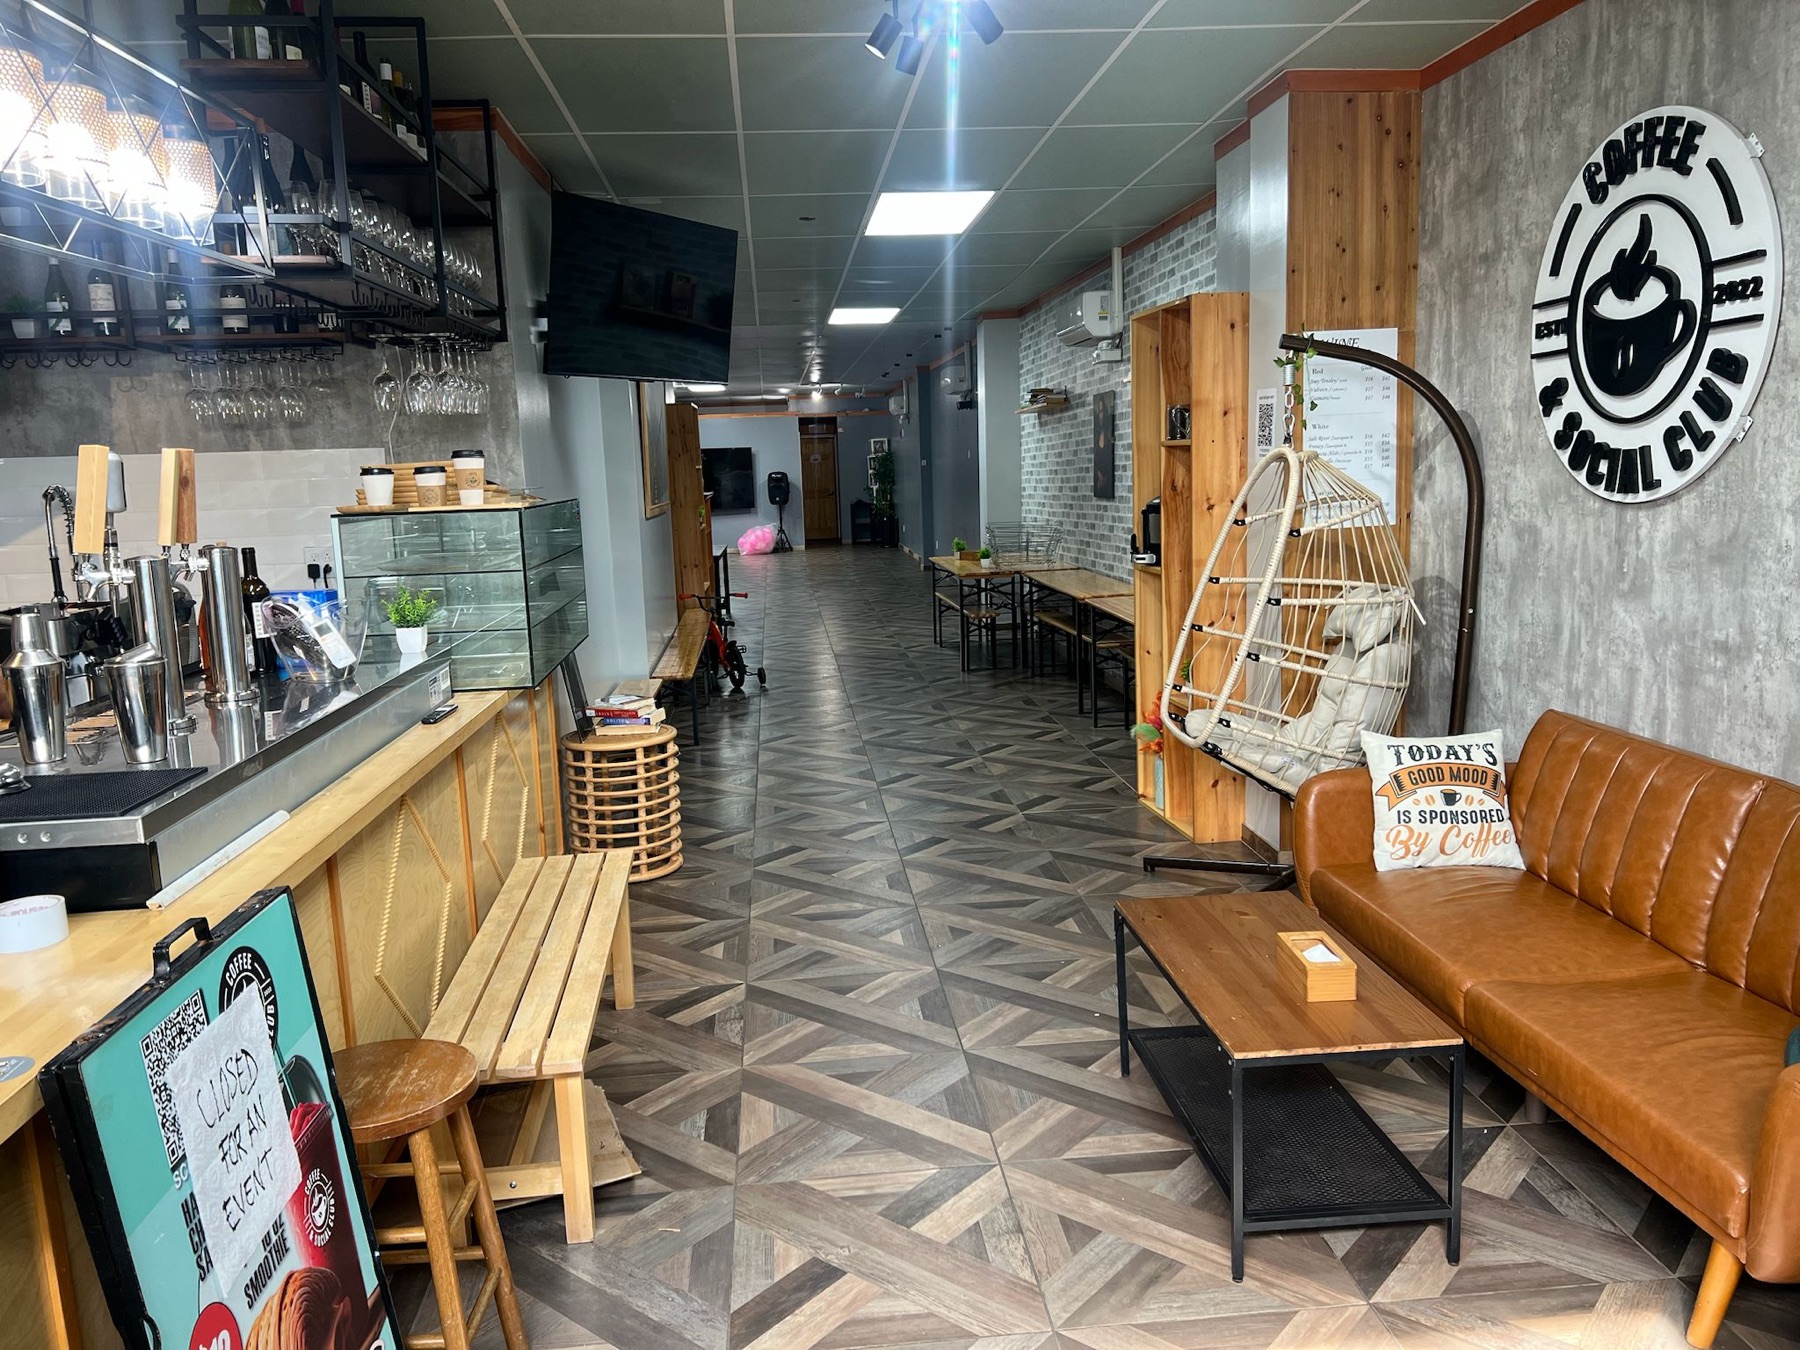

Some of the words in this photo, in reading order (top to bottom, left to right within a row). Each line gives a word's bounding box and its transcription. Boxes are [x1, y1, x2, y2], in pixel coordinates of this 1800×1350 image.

[1582, 115, 1706, 204] COFFEE
[1712, 275, 1764, 305] 2022
[1554, 411, 1662, 495] SOCIAL
[1662, 347, 1749, 472] CLUB
[1387, 743, 1498, 767] TODAY'S
[1407, 768, 1445, 786] GOOD
[1449, 766, 1488, 786] MOOD
[1397, 810, 1412, 825] IS
[1418, 808, 1505, 825] SPONSORED
[1385, 824, 1433, 861] By
[1439, 822, 1512, 858] Coffee
[225, 952, 252, 987] COFFEE
[266, 1004, 275, 1037] LUB
[196, 1048, 259, 1129] CLOSED
[219, 1123, 248, 1174] FOR
[247, 1094, 268, 1147] AN
[222, 1147, 274, 1232] EVENT
[244, 1228, 290, 1311] SMOOTHIE
